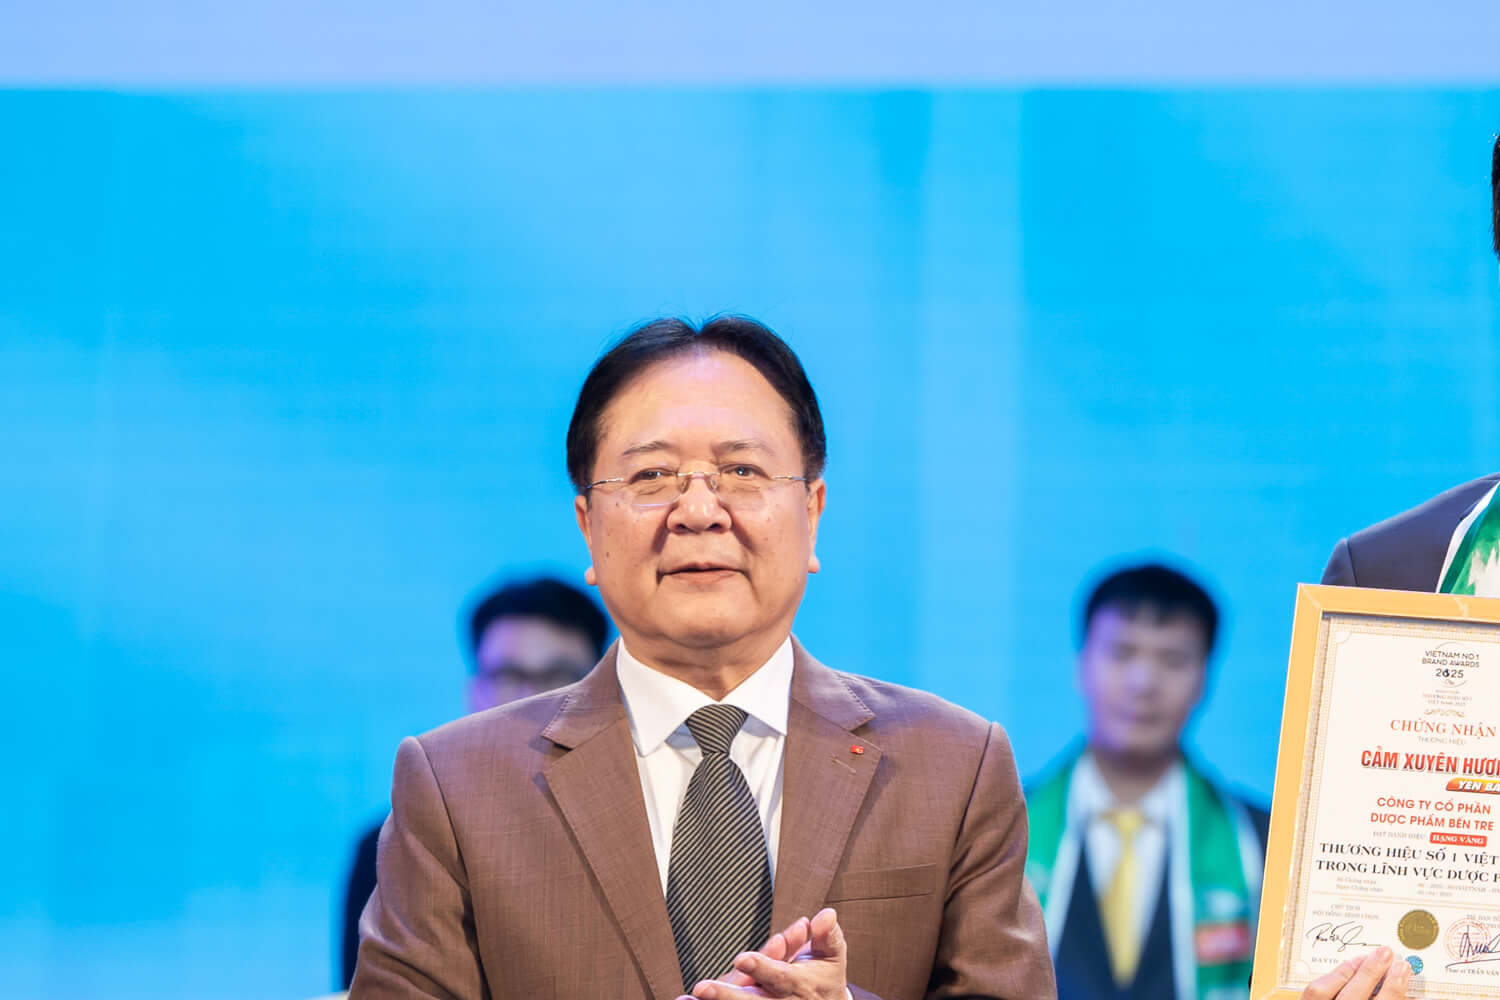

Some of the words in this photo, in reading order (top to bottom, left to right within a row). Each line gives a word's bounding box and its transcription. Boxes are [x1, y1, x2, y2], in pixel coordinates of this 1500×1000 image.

[1421, 657, 1447, 666] BRAND
[1449, 659, 1480, 668] AWARDS
[1425, 650, 1460, 658] VIETNAM
[1435, 668, 1464, 678] 2025
[1390, 717, 1447, 734] CHỨNG
[1452, 721, 1497, 740] NHẬN
[1361, 745, 1399, 769] CẢM
[1403, 751, 1457, 773] XUYÊN
[1377, 795, 1415, 809] CÔNG
[1418, 800, 1431, 810] TY
[1434, 797, 1454, 812] CỔ
[1457, 800, 1491, 815] PHẦN
[1370, 812, 1406, 826] DƯỢC
[1410, 813, 1445, 827] PHẨM
[1448, 815, 1471, 829] BẾN
[1474, 820, 1495, 831] TRE
[1320, 843, 1381, 857] THƯƠNG
[1386, 846, 1422, 861] HIỆU
[1425, 847, 1446, 862] SỐ
[1452, 853, 1457, 862] 1
[1464, 851, 1499, 867] VIỆT
[1316, 860, 1368, 874] TRONG
[1372, 862, 1408, 877] LĨNH
[1413, 866, 1443, 881] VỰC
[1447, 869, 1489, 884] DƯỢC
